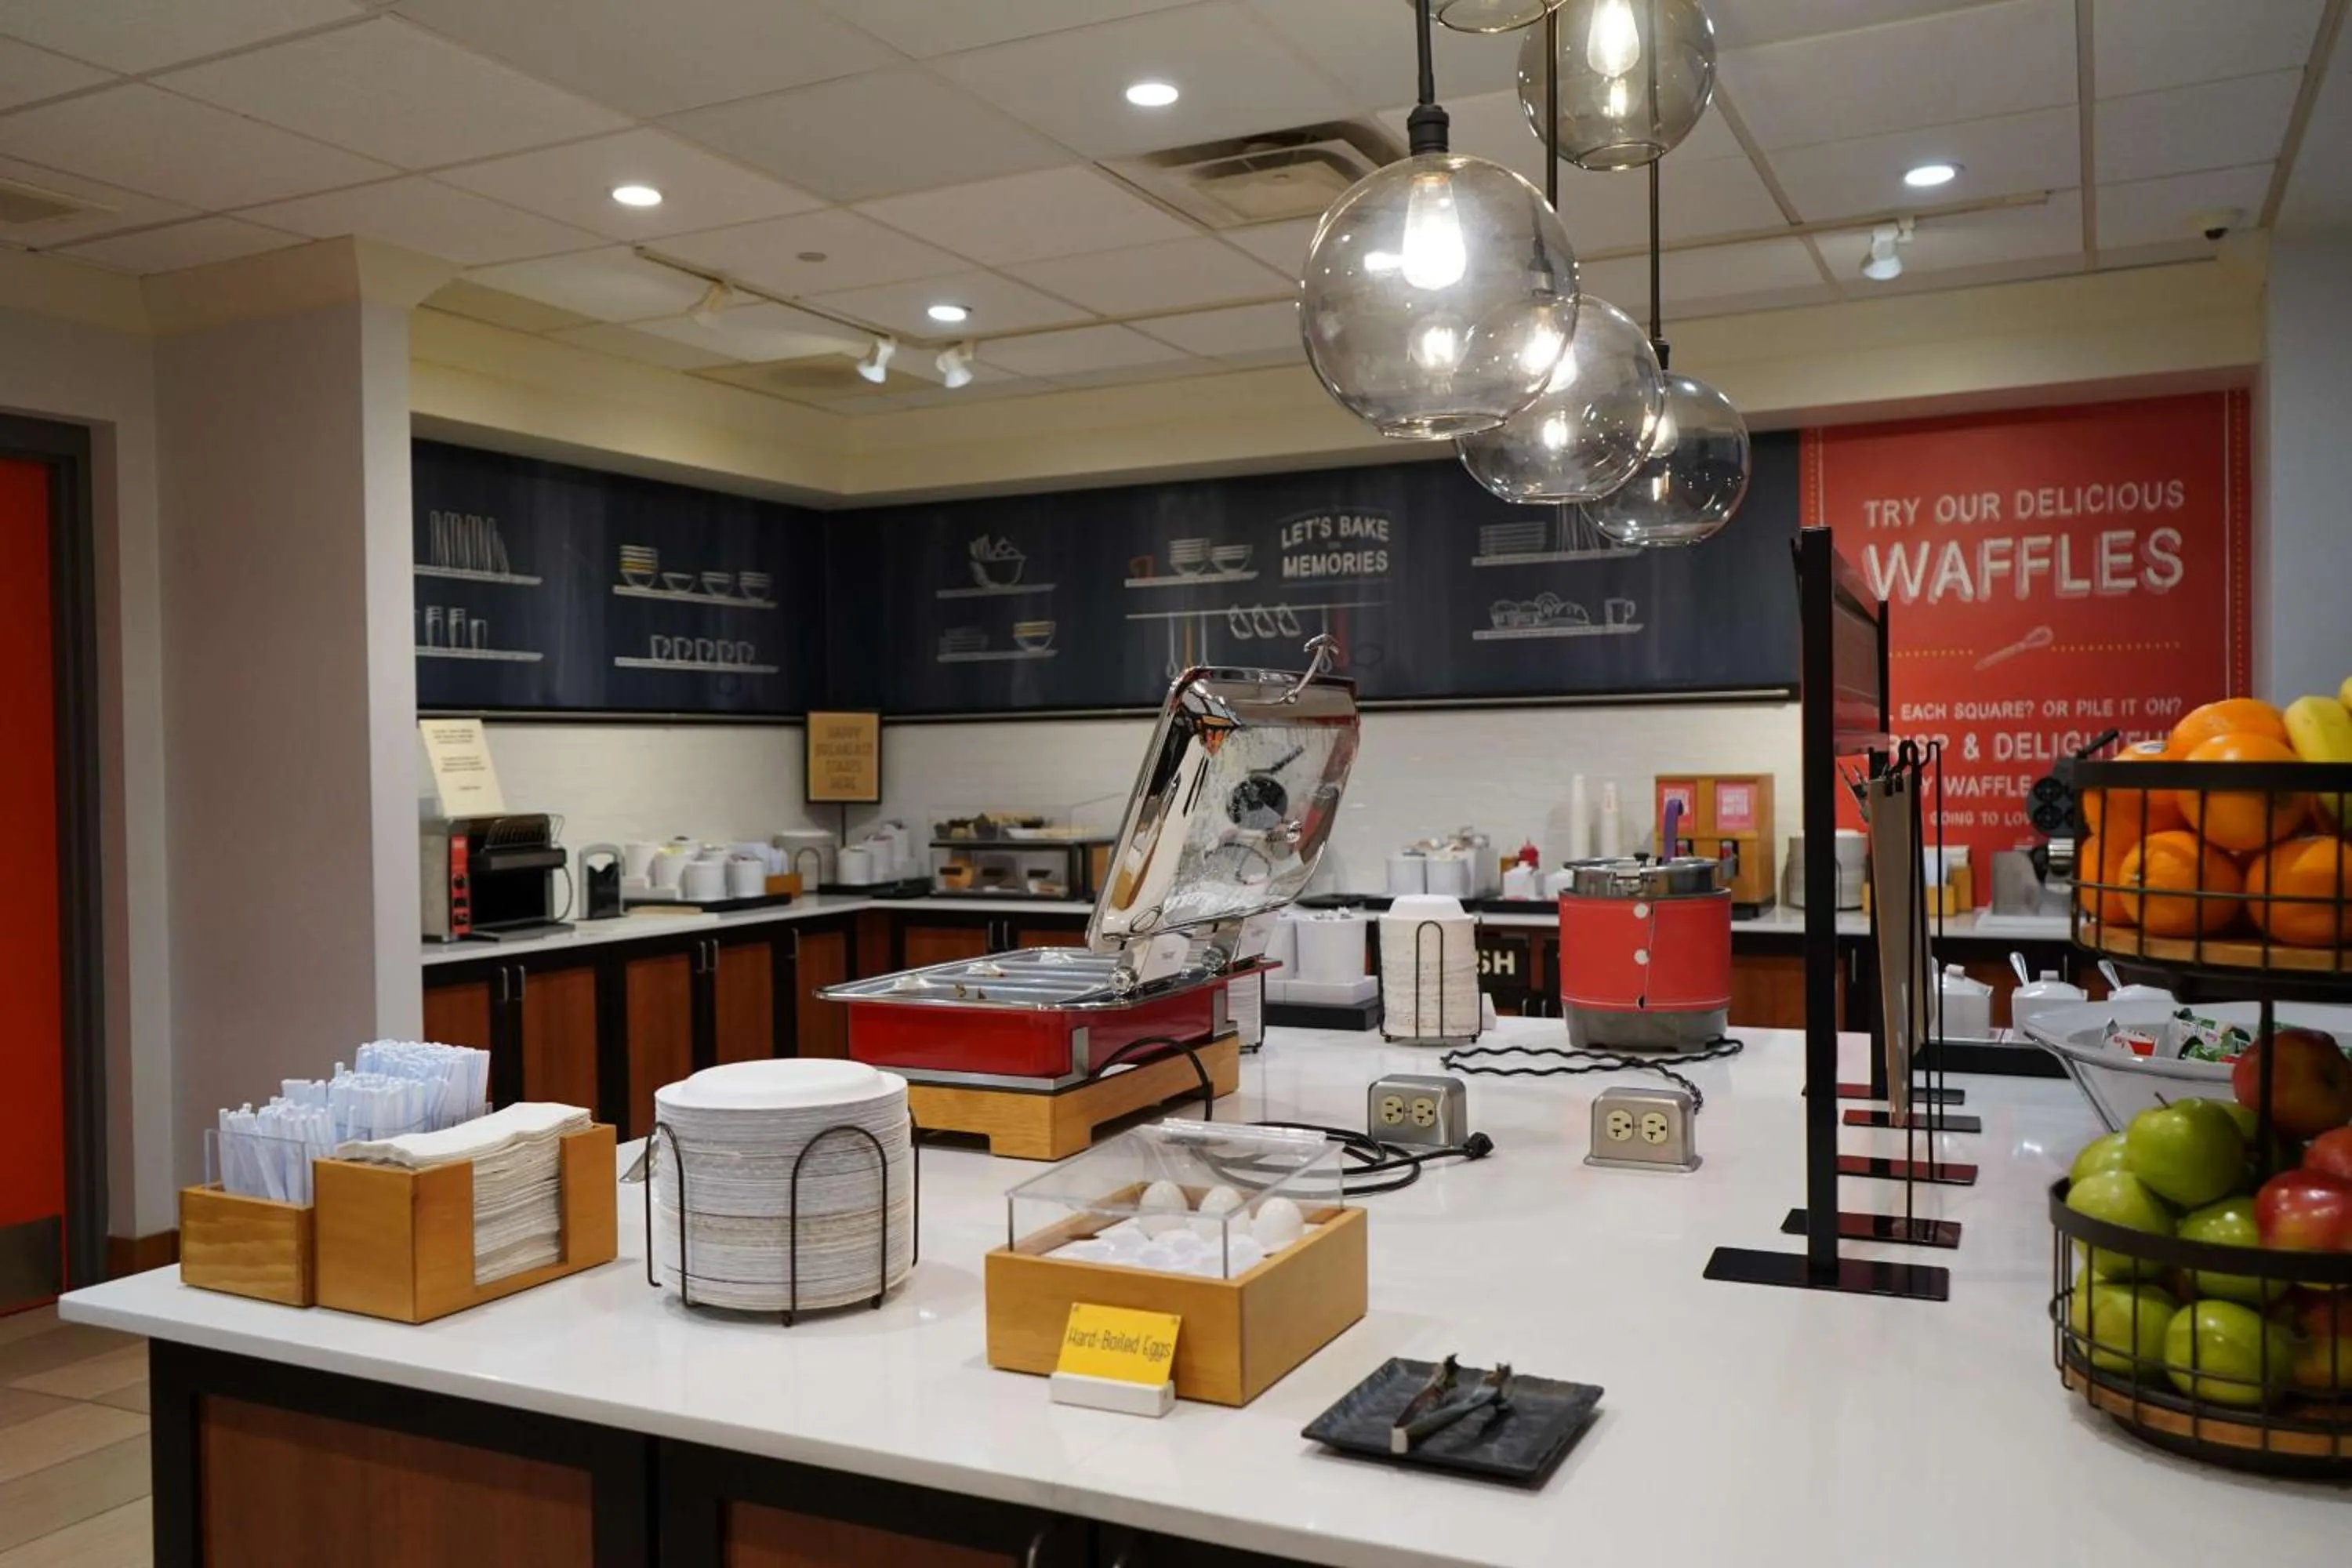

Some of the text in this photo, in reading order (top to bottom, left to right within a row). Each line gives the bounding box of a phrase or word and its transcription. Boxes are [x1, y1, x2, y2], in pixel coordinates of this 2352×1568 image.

[1863, 479, 2185, 528] TRY OUR DELICIOUS
[1281, 515, 1390, 550] LET'S BAKE
[1282, 550, 1388, 579] MEMORIES
[1864, 527, 2184, 604] WAFFLES
[1900, 696, 2183, 721] EACH SQUARE? OR PILE IT ON?
[1963, 731, 1980, 760] &
[1981, 811, 1999, 826] TO
[1142, 1335, 1173, 1362] Eggs
